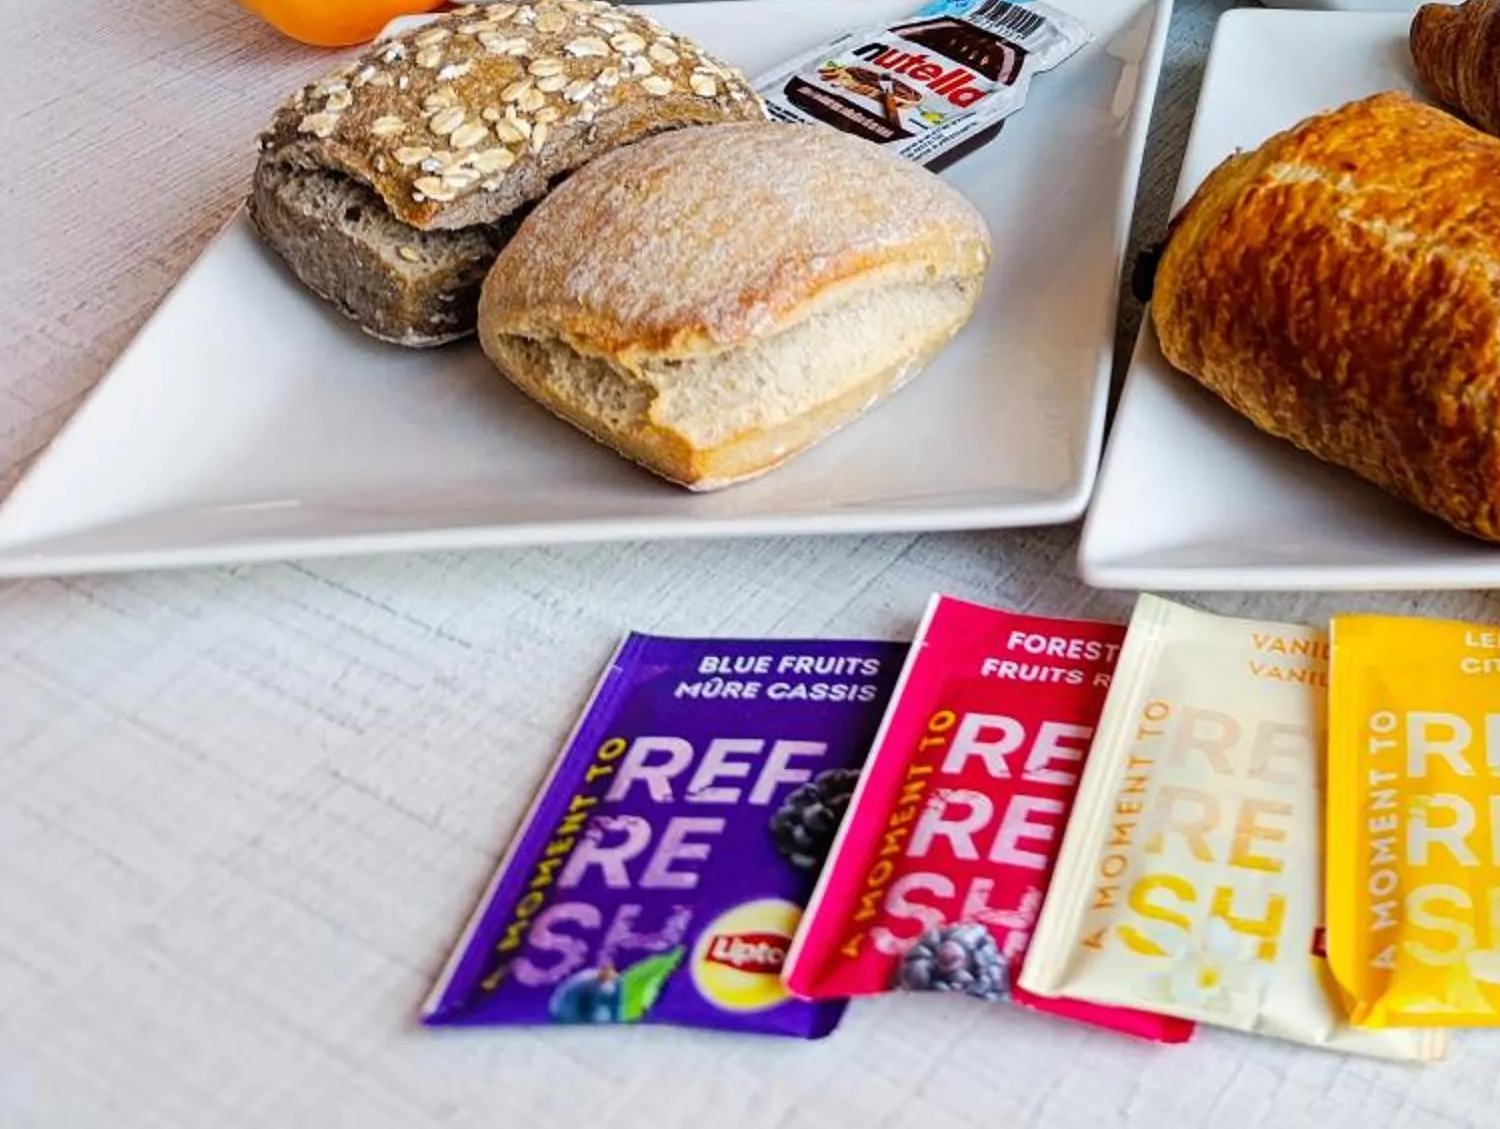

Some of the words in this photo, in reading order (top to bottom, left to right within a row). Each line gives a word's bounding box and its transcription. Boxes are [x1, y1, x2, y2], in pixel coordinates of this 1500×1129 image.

[852, 41, 989, 108] nutella
[698, 655, 773, 674] BLUE
[777, 656, 881, 676] FRUITS
[981, 658, 1084, 684] FRUITS
[1007, 631, 1120, 661] FOREST
[674, 677, 761, 699] MÛRE
[767, 682, 878, 701] CASSIS
[1138, 700, 1171, 739] TO
[940, 712, 1094, 786] RE
[1368, 710, 1398, 755] TO
[603, 736, 828, 805] REF
[496, 794, 598, 952] MOMENT
[585, 737, 627, 783] TO
[556, 815, 727, 889] RE
[841, 933, 864, 958] A
[854, 764, 934, 921] MOMENT
[918, 710, 956, 751] TO
[905, 788, 1065, 870] RE
[1090, 754, 1157, 912] MOMENT
[1145, 784, 1293, 875] RE
[1368, 769, 1398, 932] MOMENT
[870, 871, 1043, 959] SH
[1082, 926, 1108, 951] A
[711, 936, 785, 967] Lipto
[1369, 944, 1397, 970] A
